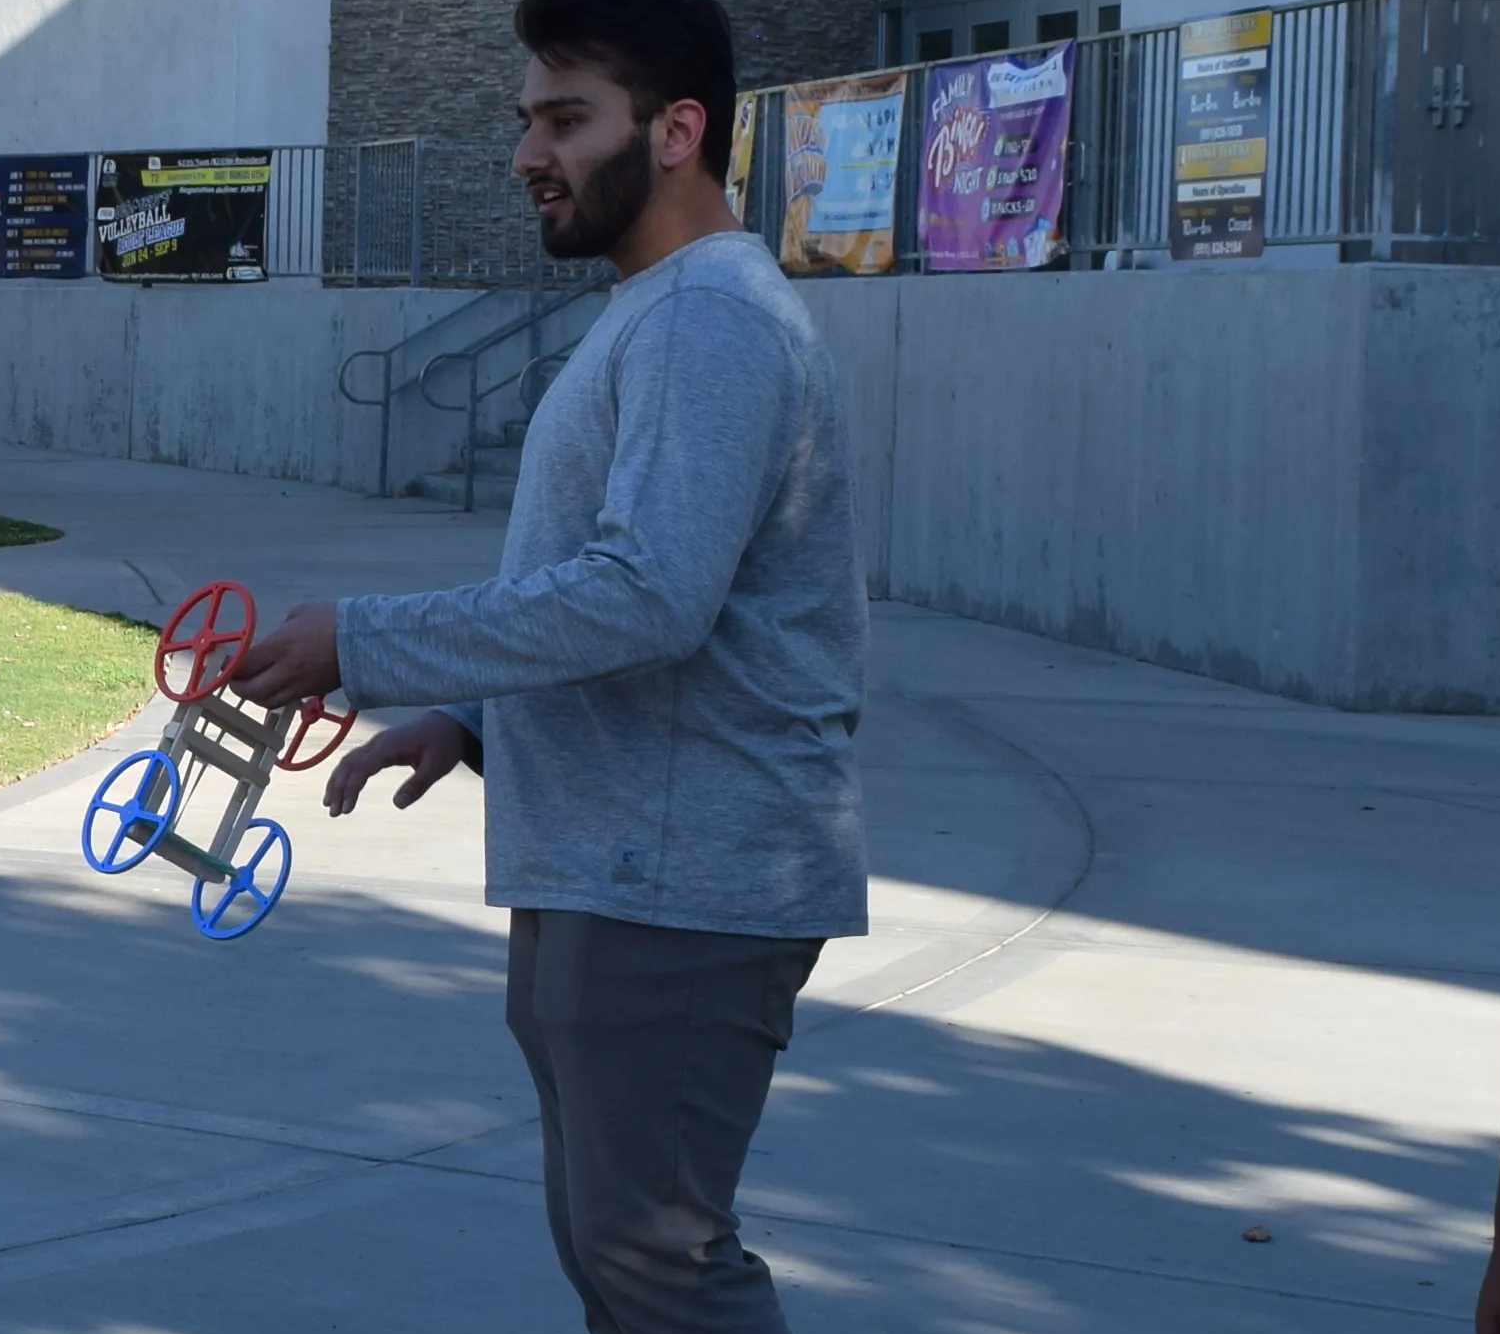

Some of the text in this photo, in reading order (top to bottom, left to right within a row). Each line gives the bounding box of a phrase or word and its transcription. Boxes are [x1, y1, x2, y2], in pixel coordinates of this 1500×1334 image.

[932, 72, 975, 122] FAMILY
[953, 167, 984, 194] NIGHT
[99, 204, 171, 243] VOLLEYBALL
[118, 219, 185, 254] ADULT LEAGUE
[1228, 217, 1252, 232] Closed
[138, 249, 148, 262] 24
[154, 242, 170, 257] SEP
